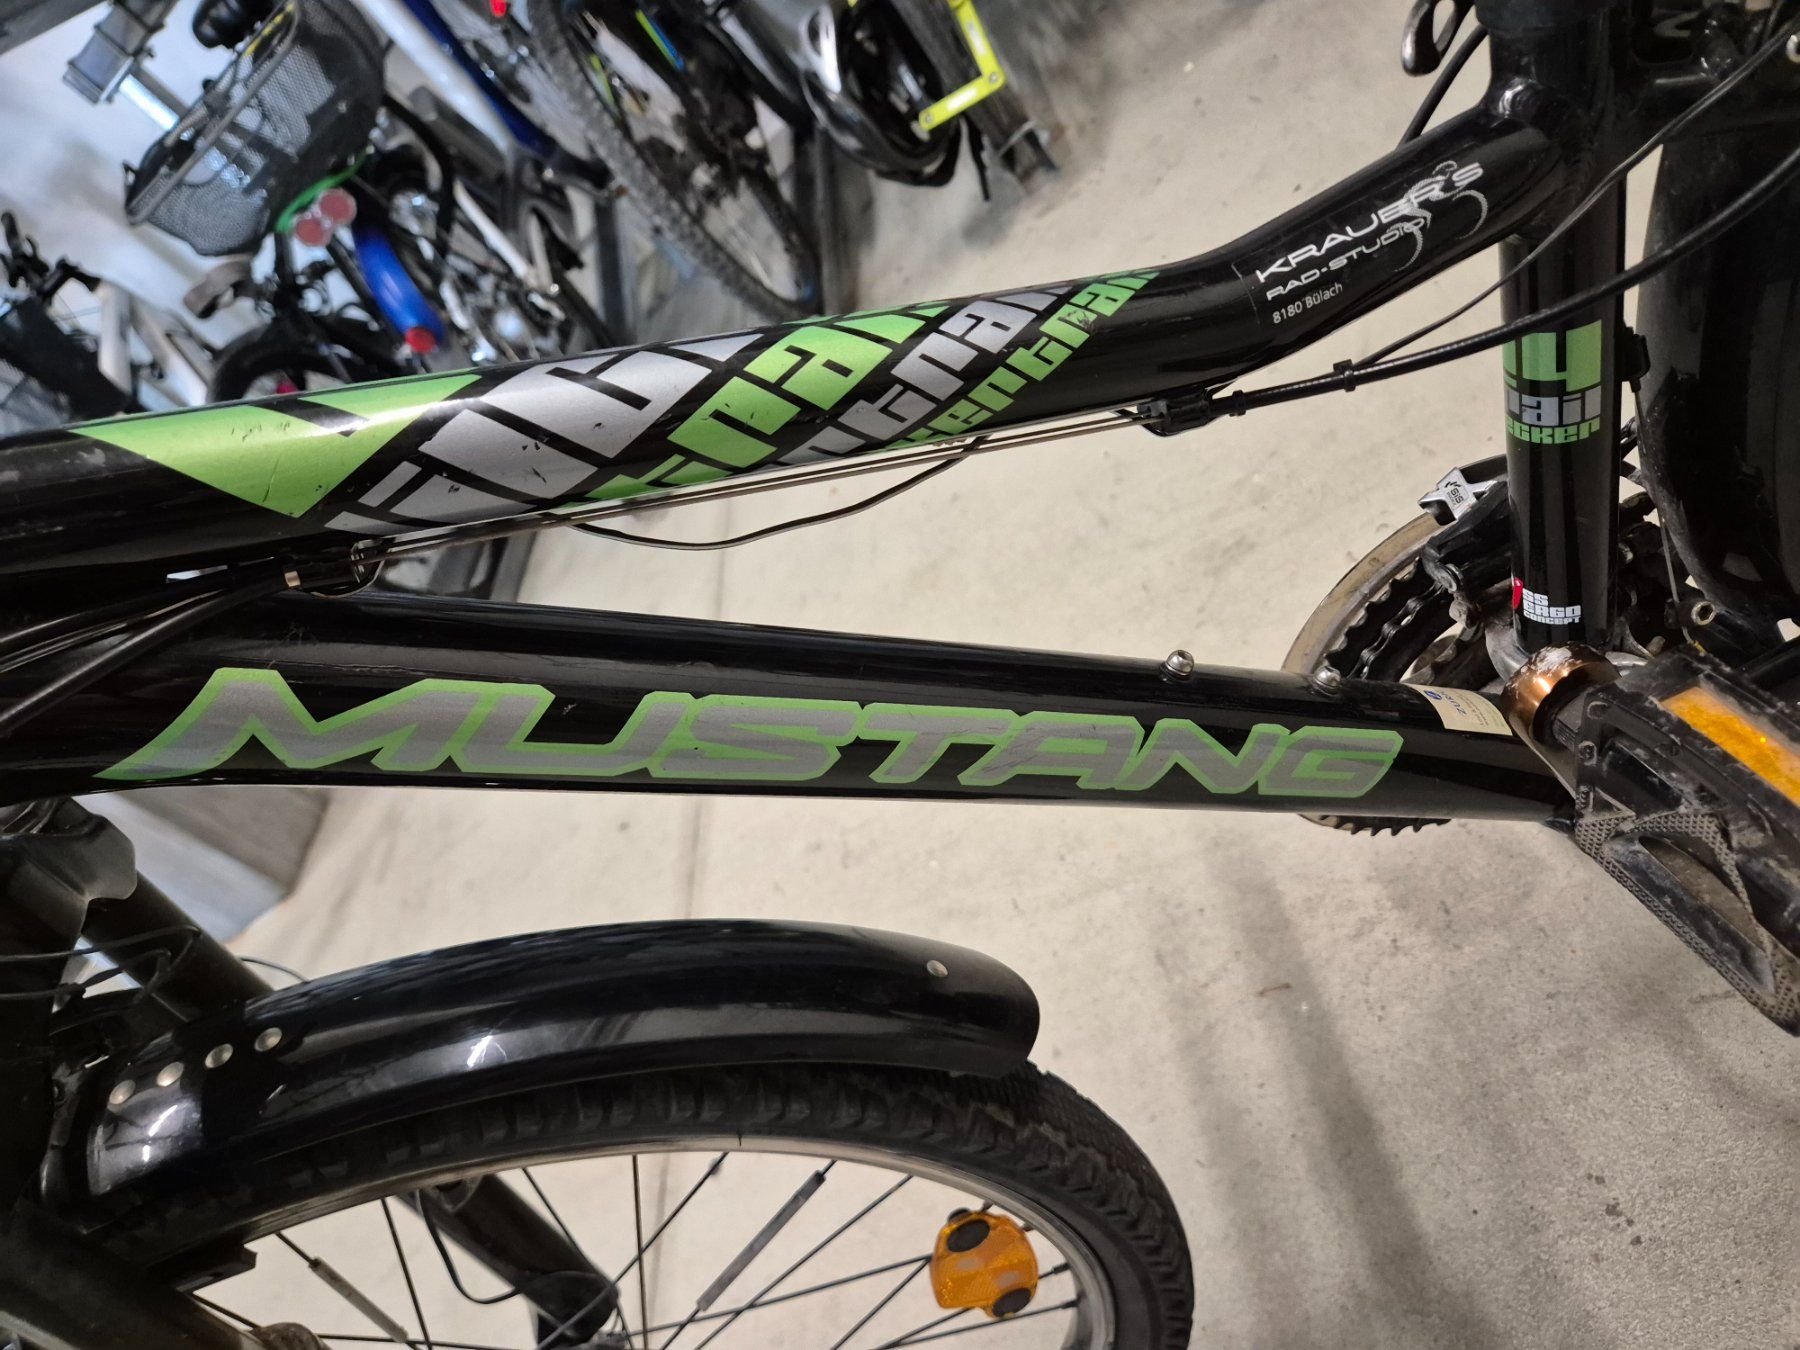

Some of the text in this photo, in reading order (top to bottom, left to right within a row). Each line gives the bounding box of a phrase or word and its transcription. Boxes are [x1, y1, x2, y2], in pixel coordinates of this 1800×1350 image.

[1272, 282, 1343, 324] 8180 Bülach
[1523, 599, 1582, 618] ERGO
[91, 667, 1404, 798] MUSTANG
